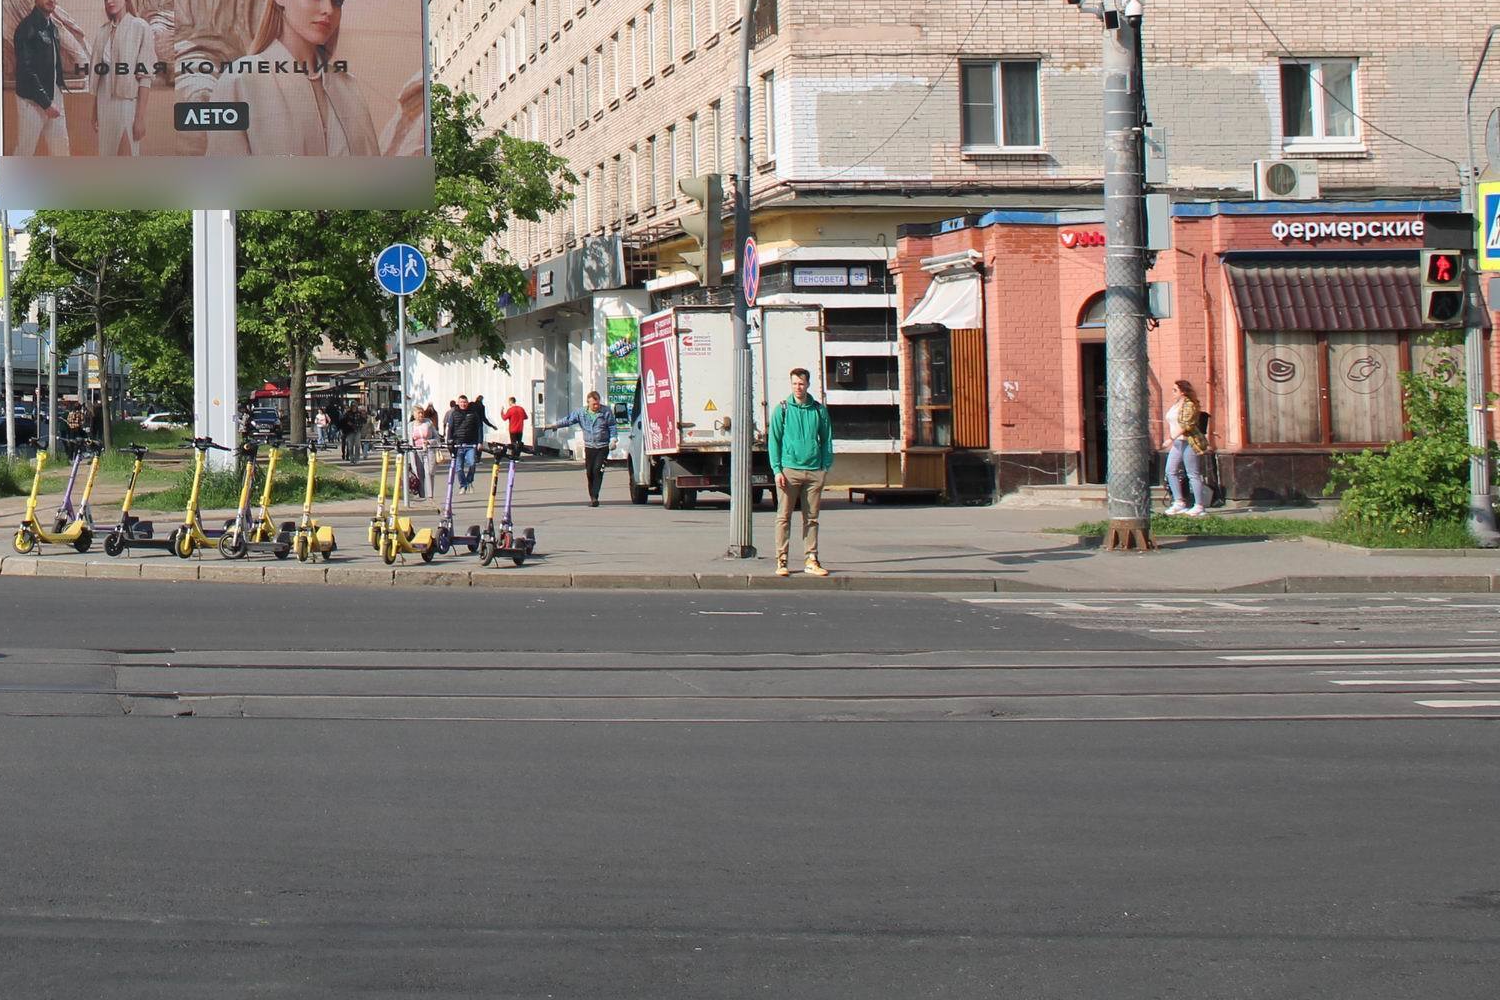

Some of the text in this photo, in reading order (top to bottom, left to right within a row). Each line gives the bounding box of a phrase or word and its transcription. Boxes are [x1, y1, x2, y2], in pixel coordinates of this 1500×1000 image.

[74, 60, 349, 76] НОВАЯ КОЛЛЕКЦИЯ
[184, 108, 239, 125] ЛЕТО
[1271, 219, 1424, 241] фермерские
